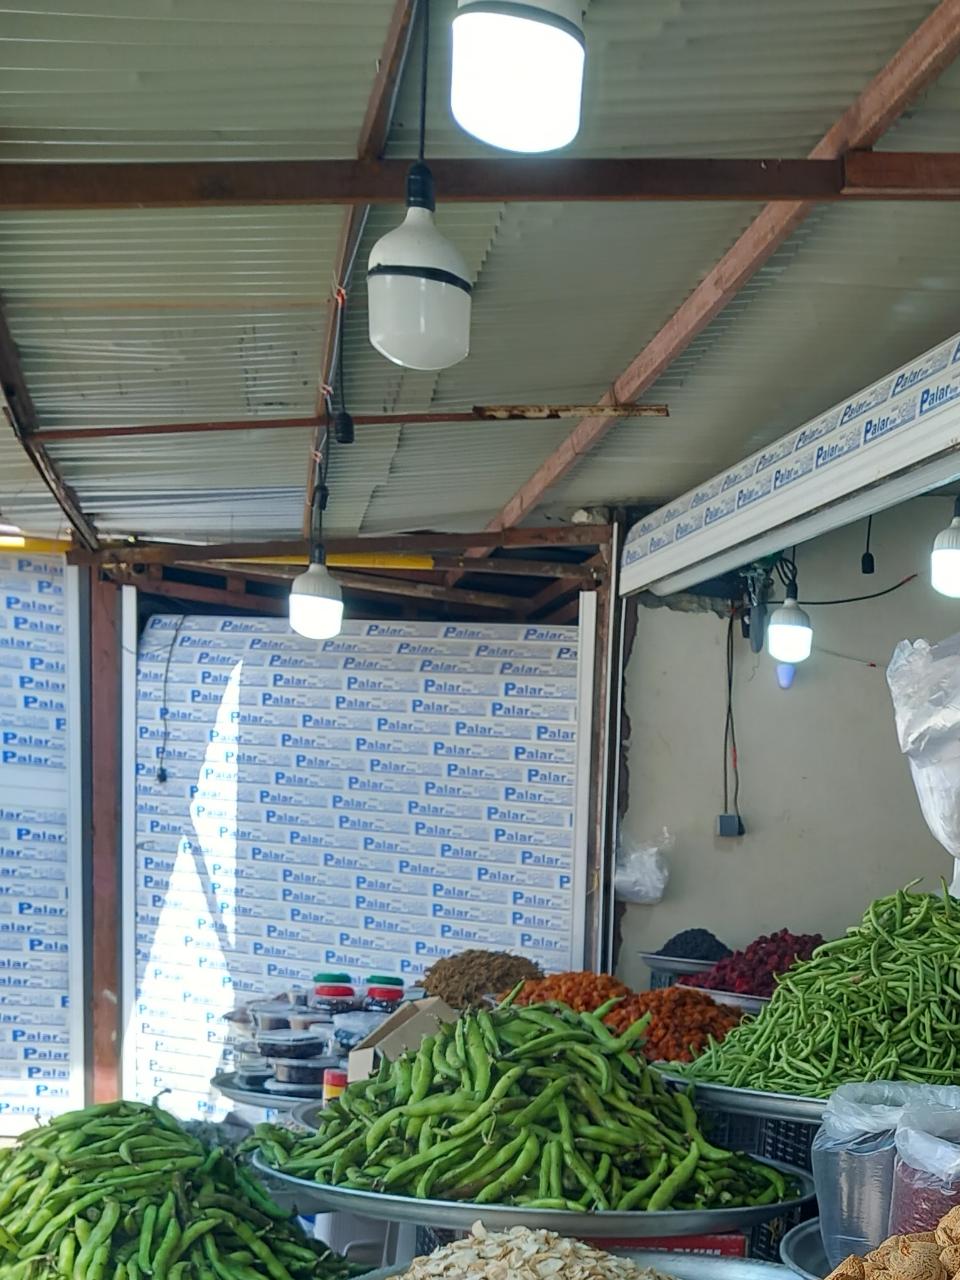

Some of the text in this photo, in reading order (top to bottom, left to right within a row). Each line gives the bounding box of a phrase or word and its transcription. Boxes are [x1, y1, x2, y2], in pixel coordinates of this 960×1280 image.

[840, 401, 866, 426] Palar
[892, 368, 921, 398] Palar
[774, 468, 793, 490] Palar
[815, 444, 838, 469] Palar
[864, 417, 889, 444] Palar
[920, 384, 950, 416] Palar
[6, 596, 54, 610] Palar
[14, 616, 62, 629] Palar
[366, 625, 402, 636] Palar
[443, 627, 481, 639] Palar
[523, 628, 564, 641] Palar
[0, 637, 32, 648] alar
[179, 636, 514, 657] Palar Palar Palar Palar Palar
[198, 652, 231, 664] Palar
[269, 654, 303, 667] Palar
[343, 657, 379, 669] Palar
[420, 659, 457, 672] Palar
[500, 662, 538, 675] Palar
[201, 671, 543, 696] Pala Palar Palar Palar Palar
[24, 696, 64, 709] Pala
[138, 689, 152, 699] lar
[262, 692, 295, 705] Palar
[335, 696, 370, 709] Palar
[412, 699, 449, 713] Palar
[492, 702, 531, 716] Palar
[160, 707, 192, 720] Palar
[302, 714, 337, 728] Palar
[377, 718, 413, 731] Palar
[455, 721, 492, 735] Palar
[536, 725, 575, 740] Palar
[3, 732, 51, 745] Palar
[139, 726, 171, 739] Palar
[281, 734, 315, 747] Palar
[356, 737, 391, 751] Palar
[433, 742, 471, 756] Palar
[514, 746, 554, 761] Palar
[2, 751, 49, 764] Palar
[156, 747, 187, 759] Palar
[296, 754, 330, 768] Palar
[370, 759, 406, 772] Palar
[447, 763, 484, 777] Palar
[528, 768, 566, 783] Palar
[275, 772, 308, 784] Palar
[349, 776, 384, 790] Palar
[425, 781, 461, 795] Palar
[504, 787, 543, 801] Palar
[260, 790, 293, 803] Palar
[332, 795, 367, 809] Palar
[408, 800, 444, 814] Palar
[487, 806, 525, 821] Palar
[138, 803, 158, 812] alar
[266, 810, 300, 823] Palar
[339, 815, 375, 829] Palar
[415, 822, 451, 835] Palar
[494, 828, 534, 842] Palar
[17, 828, 64, 841] Palar
[150, 820, 182, 833] Palar
[290, 831, 324, 845] Palar
[364, 836, 399, 850] Palar
[441, 843, 478, 858] Palar
[521, 851, 559, 865] Palar
[252, 847, 515, 881] Palar Palar Palar Palar
[283, 869, 316, 882] Palar
[356, 876, 391, 889] Palar
[432, 883, 470, 897] Palar
[513, 891, 551, 906] Palar
[19, 902, 64, 915] Palar
[282, 888, 316, 901] Palar
[356, 896, 391, 909] Palar
[432, 903, 470, 918] Palar
[512, 912, 550, 926] Palar
[1, 923, 32, 931] alar
[267, 925, 301, 938] Palar
[340, 932, 375, 947] Palar
[291, 908, 324, 922] Palar
[364, 916, 399, 930] Palar
[441, 924, 478, 939] Palar
[521, 933, 559, 948] Palar
[30, 938, 68, 951] Pala
[0, 960, 28, 969] alar
[253, 942, 428, 972] Palar Palar Pala
[267, 963, 301, 977] Palar
[0, 977, 29, 986] alar
[13, 1029, 58, 1042] Palar
[28, 1066, 69, 1079] Pala
